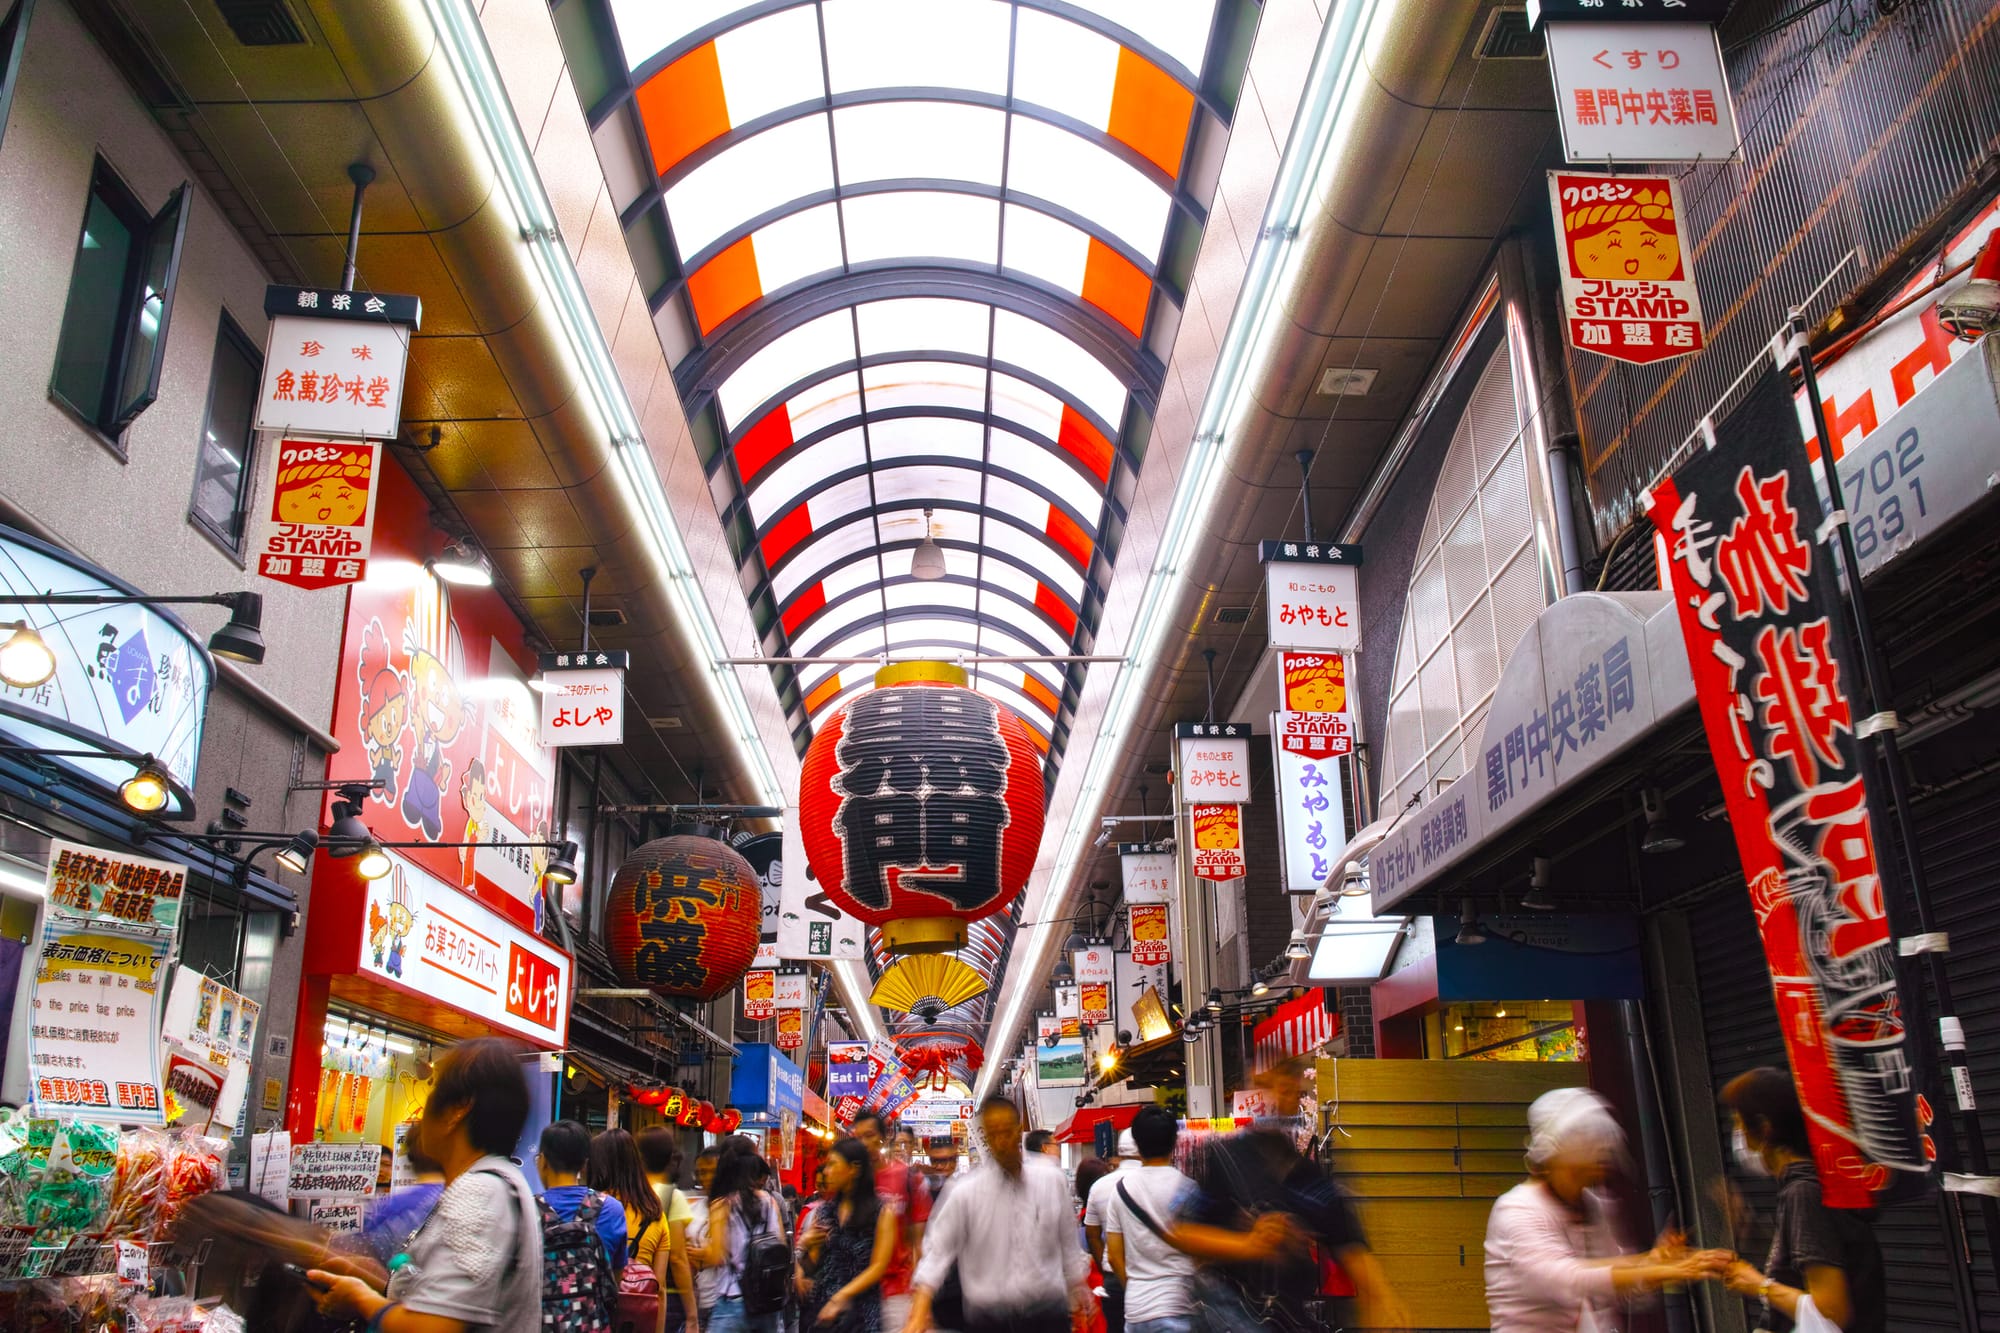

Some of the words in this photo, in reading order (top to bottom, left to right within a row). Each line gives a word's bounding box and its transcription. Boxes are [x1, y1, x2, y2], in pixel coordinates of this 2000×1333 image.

[1592, 50, 1680, 69] くすり
[1574, 88, 1718, 126] 黒門中央薬局
[1563, 182, 1633, 206] クロモン
[1582, 280, 1674, 298] フレッシュ
[298, 291, 386, 313] 親栄会
[1576, 298, 1689, 319] STAMP
[1579, 323, 1694, 347] 加盟店
[273, 369, 391, 408] 魚萬珍味堂
[282, 447, 342, 464] クロモン
[278, 524, 352, 540] フレッシュ
[268, 536, 362, 555] STAMP
[1284, 544, 1342, 559] 親栄会
[265, 557, 361, 579] 加盟店
[1280, 604, 1348, 627] みやもと
[557, 654, 608, 666] 親栄会
[1285, 657, 1324, 670] クロモン
[552, 707, 613, 728] よしや
[1291, 712, 1339, 722] フレッシュ
[1486, 635, 1635, 813] 黒門中央薬局
[1286, 721, 1347, 734] STAMP
[1287, 736, 1348, 751] 加盟店
[1190, 770, 1241, 787] みやもと
[488, 750, 543, 833] よしや
[1195, 807, 1223, 817] クロモン
[1300, 764, 1329, 880] みやもと
[1376, 794, 1468, 897] 処方せん・保険調剤
[1196, 856, 1241, 865] STAMP
[1197, 866, 1242, 875] 加盟店
[1132, 908, 1154, 917] クロモン
[42, 943, 162, 969] 表示価格について
[425, 920, 499, 982] お菓子のデパート
[1134, 945, 1167, 953] STAMP
[51, 970, 72, 982] sales
[79, 972, 93, 984] tax
[118, 976, 128, 988] be
[134, 979, 157, 990] added
[509, 954, 557, 1022] よしや
[33, 999, 41, 1008] to
[49, 999, 62, 1010] the
[69, 1001, 90, 1014] price
[96, 1003, 110, 1016] tag
[116, 1005, 135, 1017] price
[830, 1072, 852, 1083] Eat
[856, 1071, 868, 1083] in
[40, 1077, 107, 1104] 魚萬珍味堂
[116, 1083, 157, 1108] 黒門店
